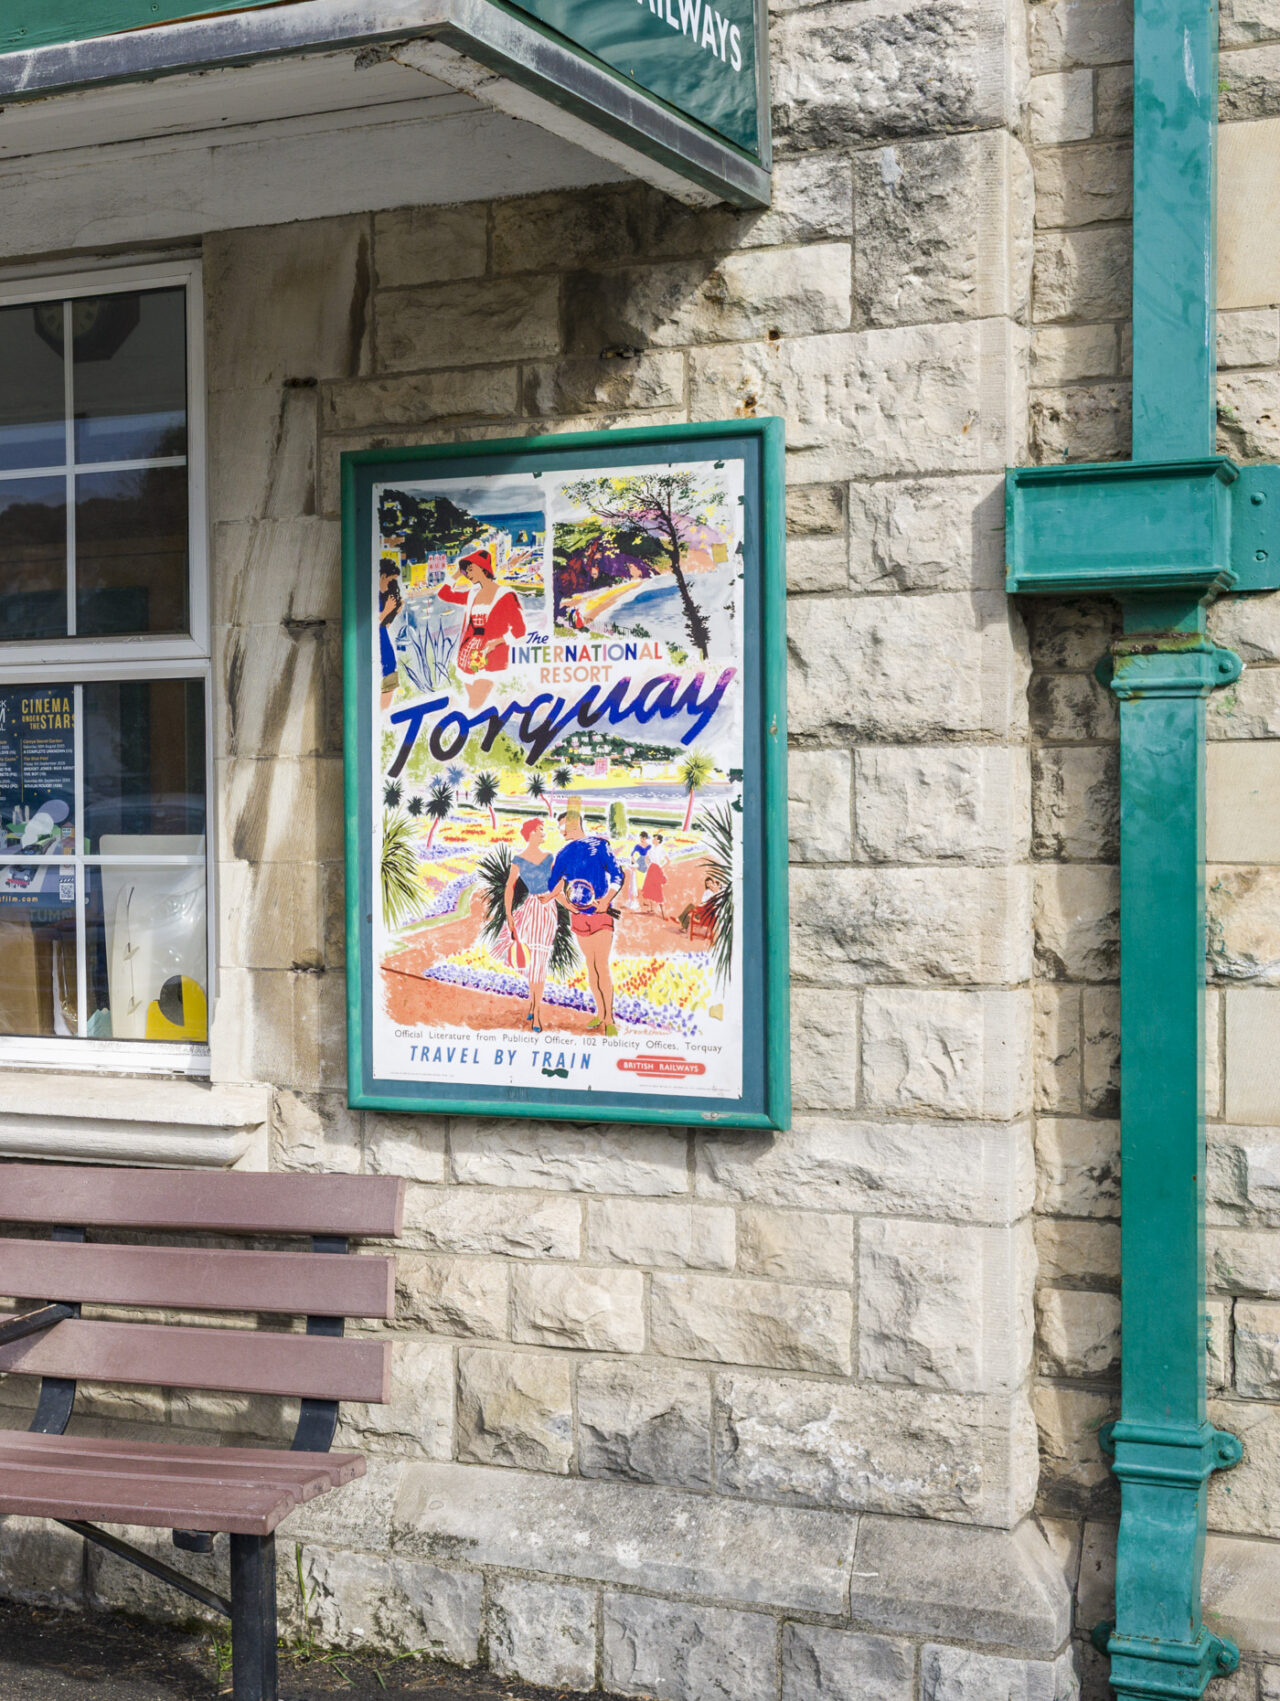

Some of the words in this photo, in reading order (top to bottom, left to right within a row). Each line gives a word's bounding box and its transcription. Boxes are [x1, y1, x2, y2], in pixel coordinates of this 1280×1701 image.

[637, 0, 742, 72] LWAYS
[526, 631, 549, 644] The
[511, 641, 662, 664] INTERNATIONAL
[540, 665, 613, 684] RESORT
[21, 698, 70, 713] CINEMA
[388, 666, 738, 779] Torquay
[394, 1029, 423, 1040] Official
[429, 1031, 471, 1042] Literature
[476, 1032, 497, 1042] from
[502, 1033, 539, 1045] Publicity
[582, 1037, 597, 1047] 102
[602, 1038, 640, 1050] Publicity
[685, 1042, 723, 1054] Torquay
[410, 1046, 480, 1064] TRAVEL
[494, 1048, 517, 1067] BY
[532, 1051, 591, 1070] TRAIN
[624, 1062, 654, 1070] BRITISH
[660, 1063, 699, 1073] RAILWAYS
